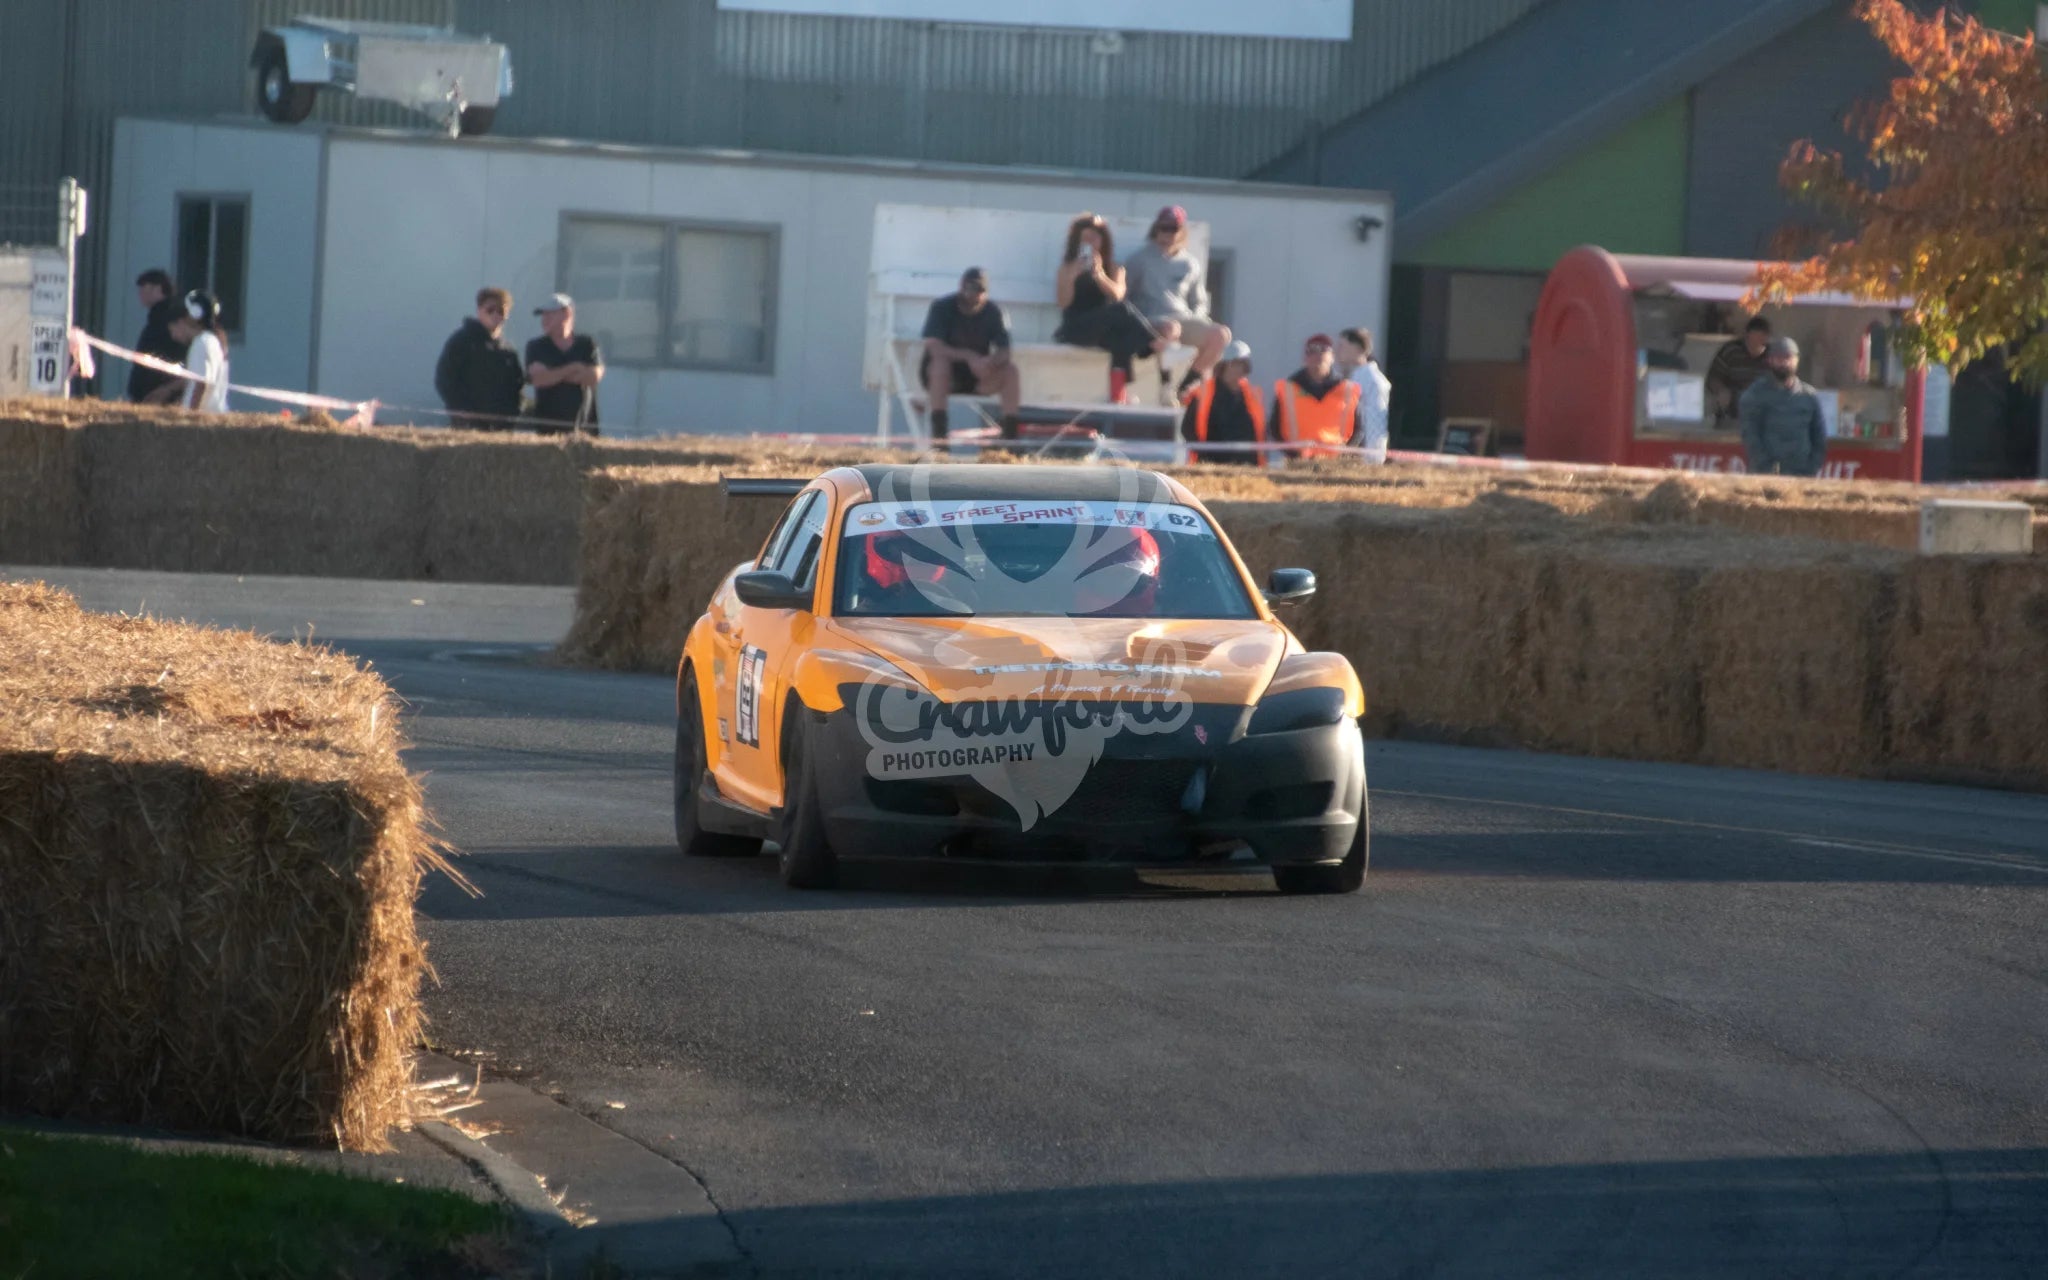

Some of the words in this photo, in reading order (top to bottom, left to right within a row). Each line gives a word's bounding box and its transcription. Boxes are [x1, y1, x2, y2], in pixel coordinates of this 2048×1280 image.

[34, 326, 63, 340] SPEED
[34, 341, 60, 354] LIMIT
[37, 357, 56, 383] 10
[941, 504, 1017, 522] STREET
[1003, 506, 1085, 523] SPRINT
[1168, 513, 1198, 528] 62
